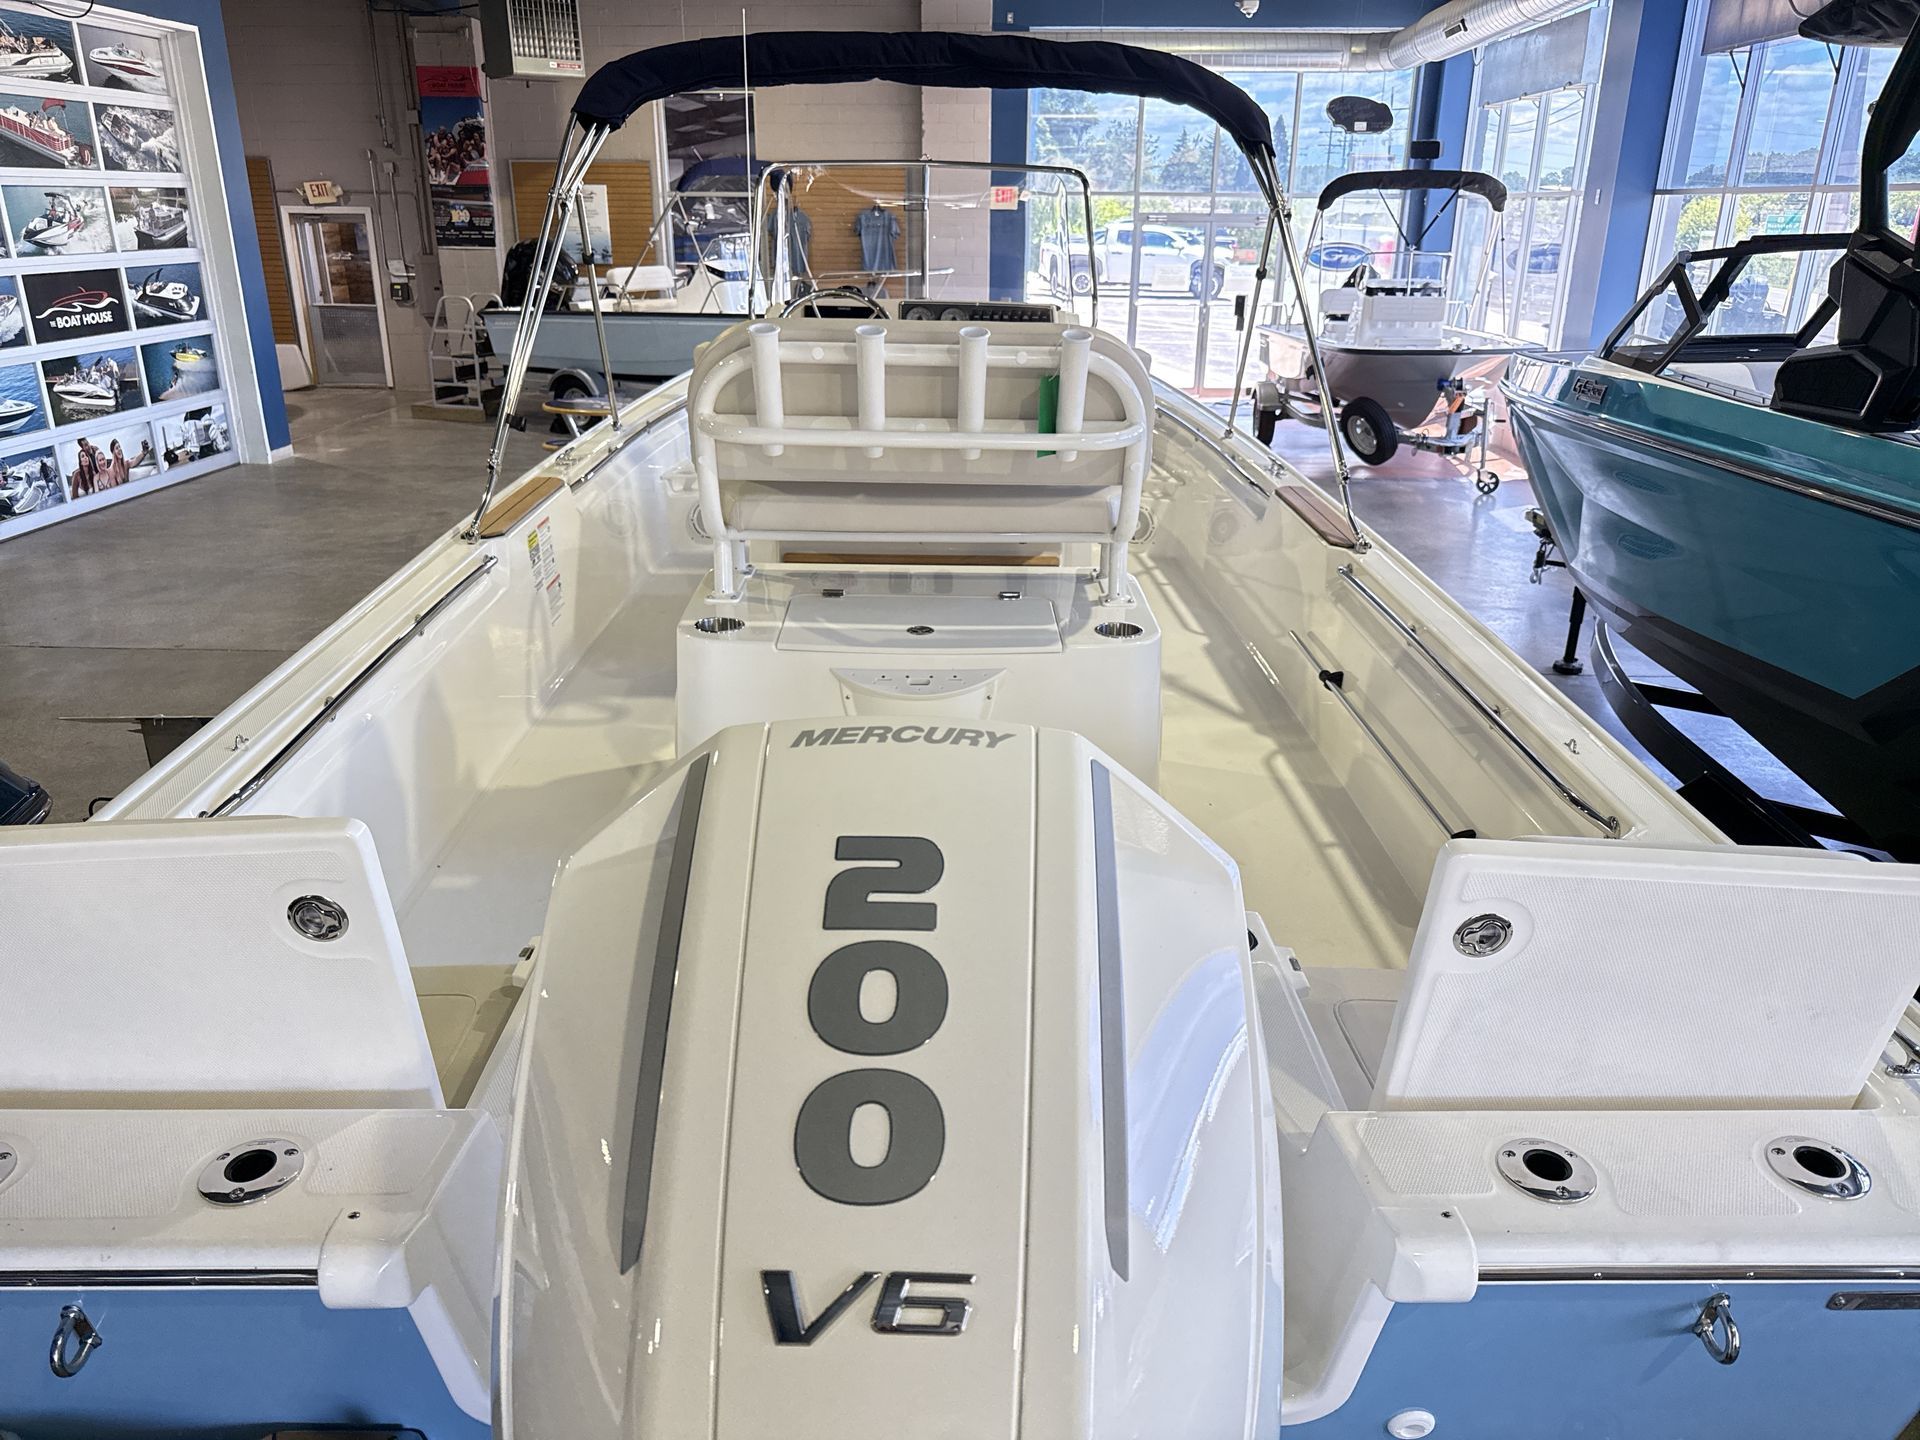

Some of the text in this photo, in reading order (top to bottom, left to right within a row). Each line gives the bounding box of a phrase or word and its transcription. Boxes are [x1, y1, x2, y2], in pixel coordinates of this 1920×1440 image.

[309, 183, 329, 198] EXIT
[995, 188, 1013, 203] EXIT
[56, 315, 81, 329] BOAT
[82, 310, 114, 325] HOUSE
[790, 725, 1017, 748] MERCURY
[794, 835, 949, 1206] 200
[759, 1269, 977, 1346] V6
